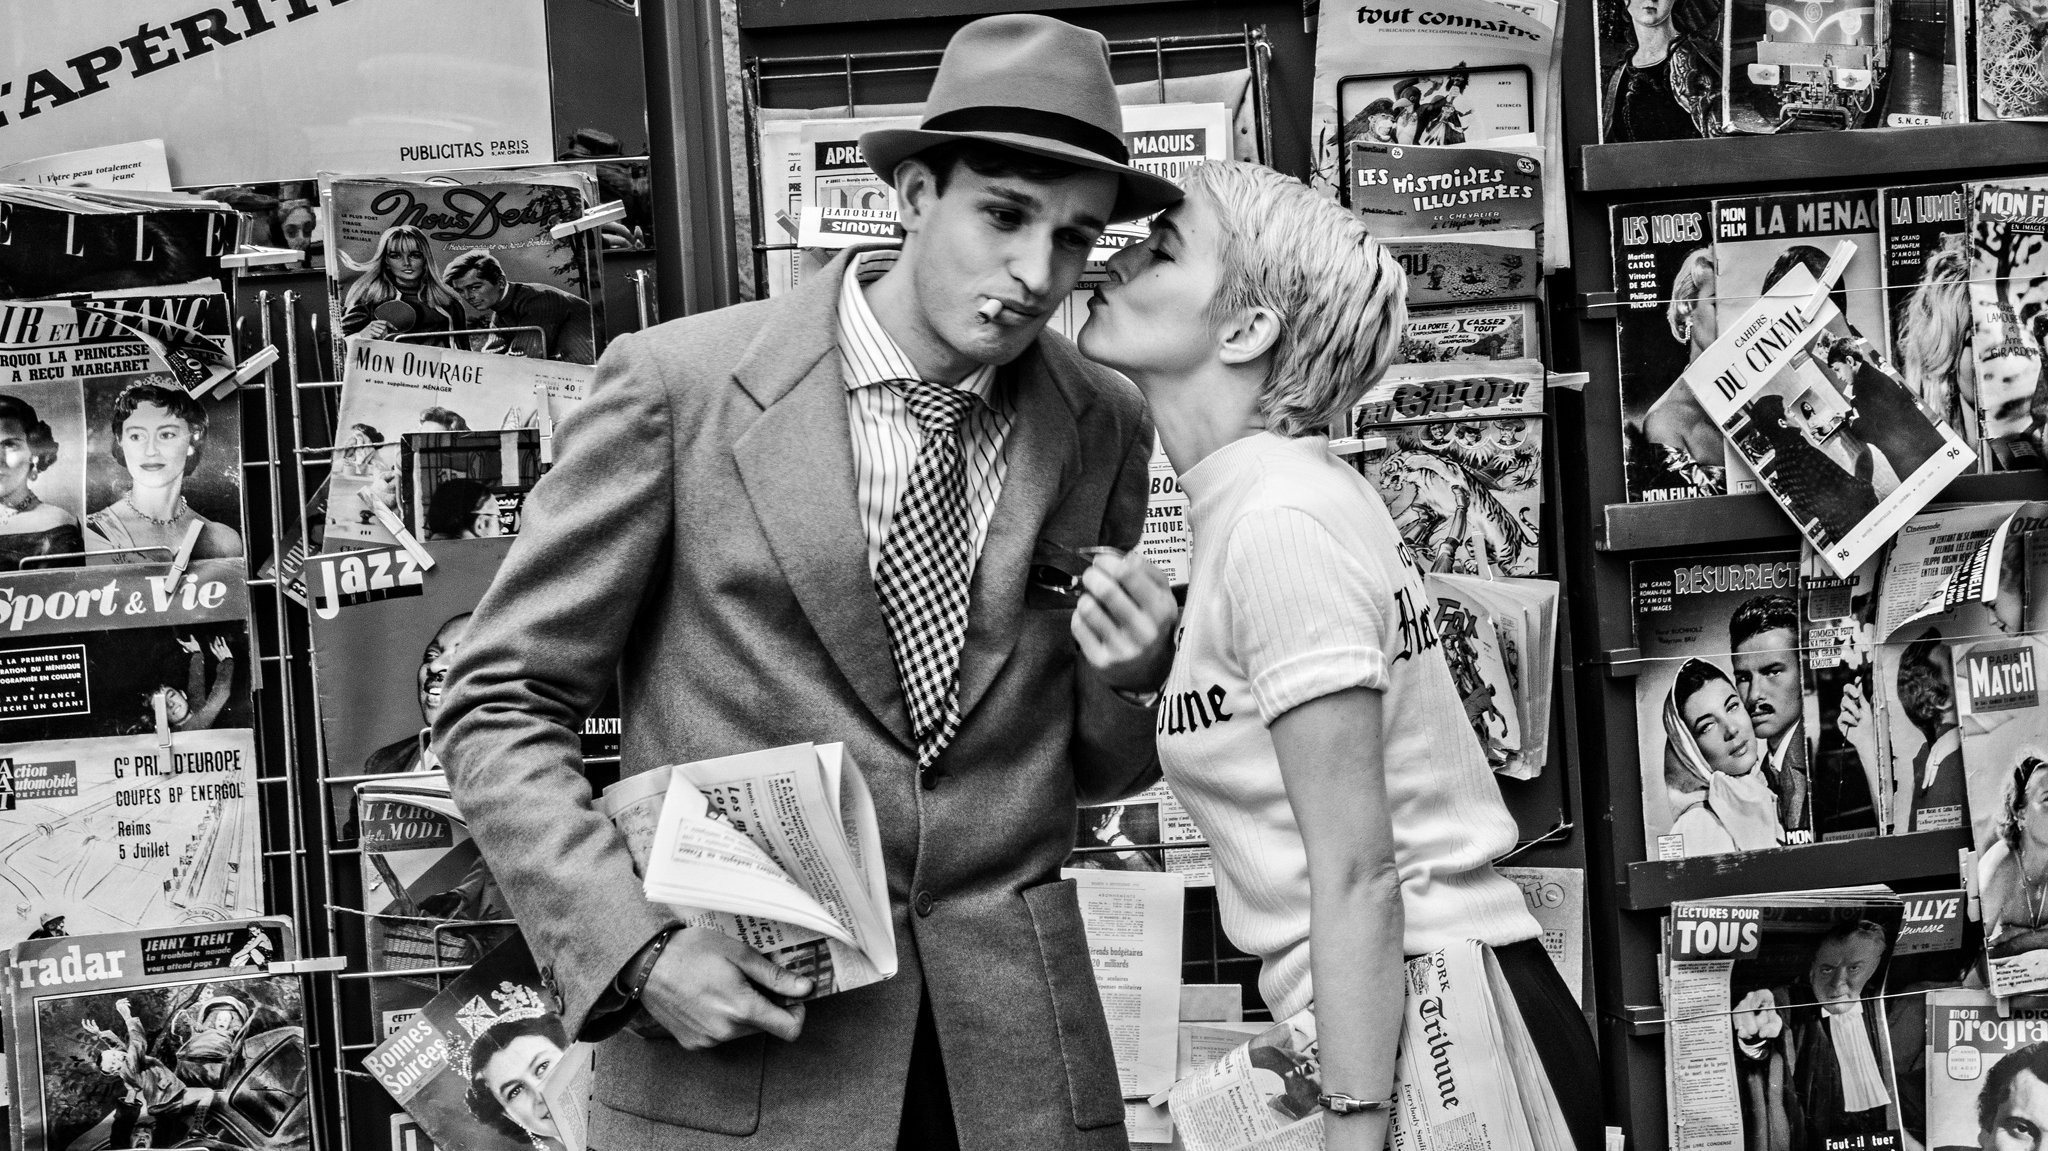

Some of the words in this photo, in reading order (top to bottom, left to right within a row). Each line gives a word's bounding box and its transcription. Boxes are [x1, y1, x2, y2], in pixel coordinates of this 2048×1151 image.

[1356, 6, 1414, 25] tout
[1418, 12, 1541, 41] connaître
[0, 0, 349, 127] 'APÉRI
[400, 142, 484, 161] PUBLICITAS
[490, 140, 529, 151] PARIS
[1133, 134, 1196, 155] MAQUIS
[825, 146, 865, 165] APRE
[72, 170, 94, 181] peau
[95, 161, 143, 174] totalement
[111, 171, 137, 183] jeune
[1357, 169, 1389, 187] LES
[1891, 197, 1912, 225] LA
[1982, 191, 2028, 216] MON
[1449, 211, 1500, 220] CHEVALIER
[1720, 207, 1746, 222] MON
[1755, 205, 1786, 236] LA
[832, 221, 895, 236] MAQUIS
[1623, 215, 1649, 246] LES
[1652, 212, 1703, 244] NOCES
[1720, 222, 1747, 237] FILM
[1628, 252, 1655, 261] Martine
[1628, 260, 1656, 269] CAROL
[1628, 272, 1656, 280] Vittorio
[1640, 280, 1657, 288] SICA
[1630, 292, 1657, 302] Philippe
[1427, 322, 1449, 330] PORTE
[1466, 318, 1506, 326] CASSEZ
[48, 323, 79, 342] ET
[1734, 313, 1768, 349] CAHIERS
[49, 350, 67, 363] LA
[75, 344, 150, 361] PRINCESSE
[12, 370, 22, 382] A
[30, 365, 65, 380] REÇU
[71, 358, 150, 377] MARGARET
[564, 384, 576, 392] 40
[1713, 361, 1748, 401] DU
[1946, 447, 1960, 460] 96
[1642, 488, 1668, 502] MON
[1905, 522, 1941, 533] Cinémonde
[1143, 536, 1186, 545] nouvelles
[1143, 546, 1186, 556] chinoises
[1837, 548, 1850, 561] 96
[316, 549, 423, 619] jazz
[0, 578, 120, 631] Sport
[124, 591, 147, 615] &
[145, 574, 227, 613] Vie
[1640, 597, 1672, 605] D'AMOUR
[1651, 604, 1672, 612] IMAGES
[21, 655, 58, 663] PREMIÈRE
[1988, 652, 2021, 664] PARIS
[51, 672, 82, 681] COULEUR
[1969, 651, 2035, 698] MATCH
[38, 691, 76, 700] FRANCE
[174, 750, 242, 774] D'EUROPE
[116, 788, 161, 807] COUPES
[169, 787, 183, 803] BP
[191, 782, 245, 801] ENERGOL
[118, 821, 151, 837] Reims
[387, 821, 448, 842] MODE
[1786, 830, 1813, 845] MON
[119, 844, 126, 859] 5
[133, 842, 170, 858] Juillet
[1677, 906, 1731, 921] LECTURES
[1732, 907, 1760, 920] POUR
[145, 936, 186, 953] JENNY
[192, 931, 234, 947] TRENT
[1677, 920, 1759, 955] TOUS
[160, 950, 201, 960] troublante
[17, 944, 126, 989] radar
[147, 965, 165, 973] vous
[166, 961, 193, 971] attend
[193, 960, 213, 970] page
[214, 958, 221, 966] 7
[1434, 947, 1451, 994] YORK
[1949, 1009, 1979, 1019] mon
[365, 1019, 433, 1079] Bonnes
[1419, 996, 1459, 1110] Tribune
[383, 1038, 449, 1095] Soirées
[1404, 1084, 1420, 1130] Everybody
[1826, 1135, 1865, 1150] Faut-il
[1872, 1135, 1894, 1146] tuer
